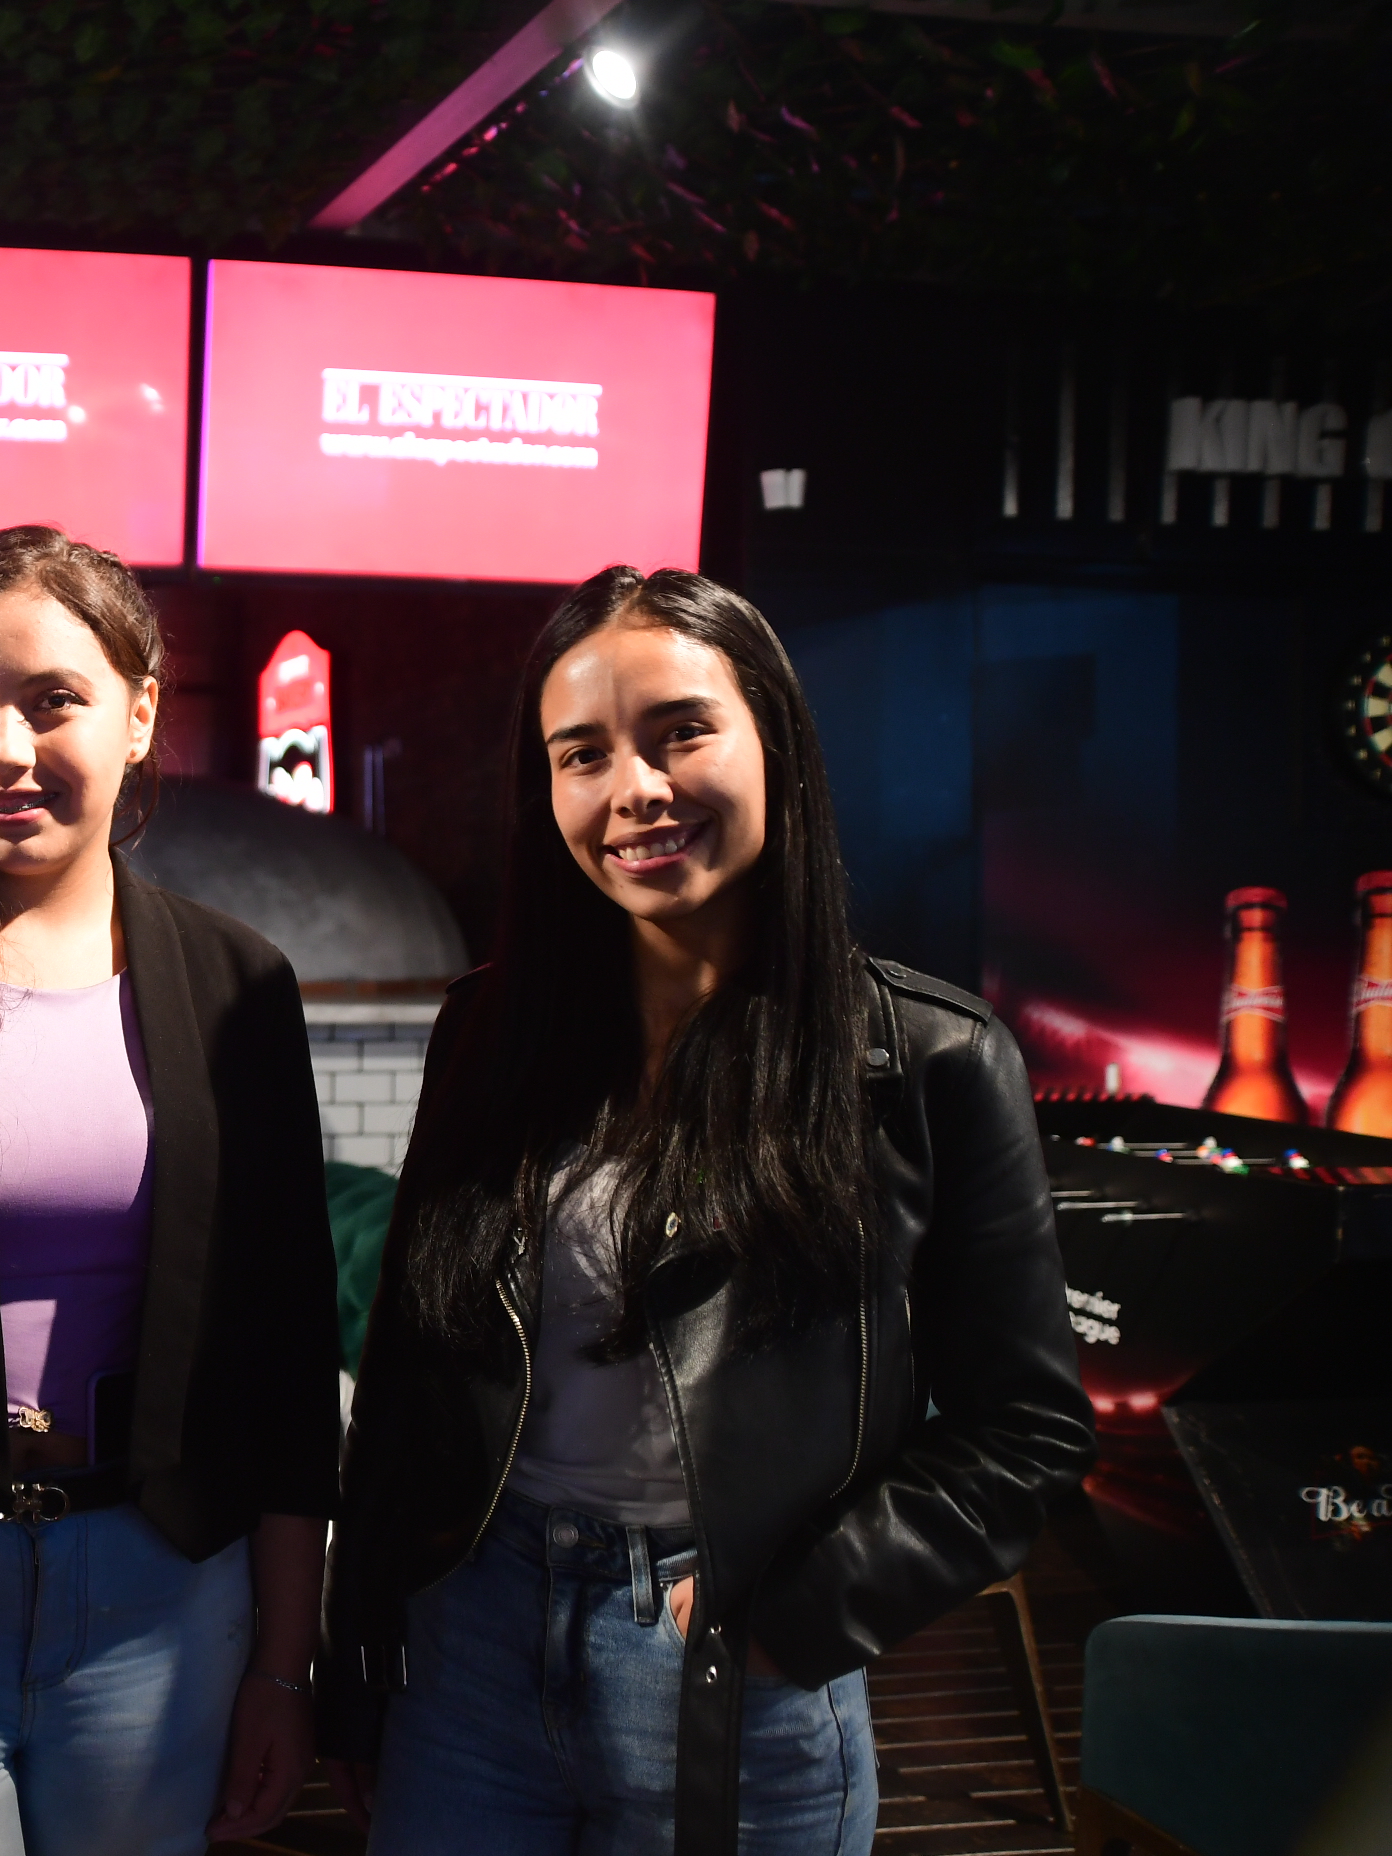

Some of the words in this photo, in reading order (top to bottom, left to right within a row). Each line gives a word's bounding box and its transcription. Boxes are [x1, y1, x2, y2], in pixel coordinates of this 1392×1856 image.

[321, 378, 370, 425] EL
[377, 380, 600, 438] ESPECTADOR
[1168, 397, 1348, 478] KING
